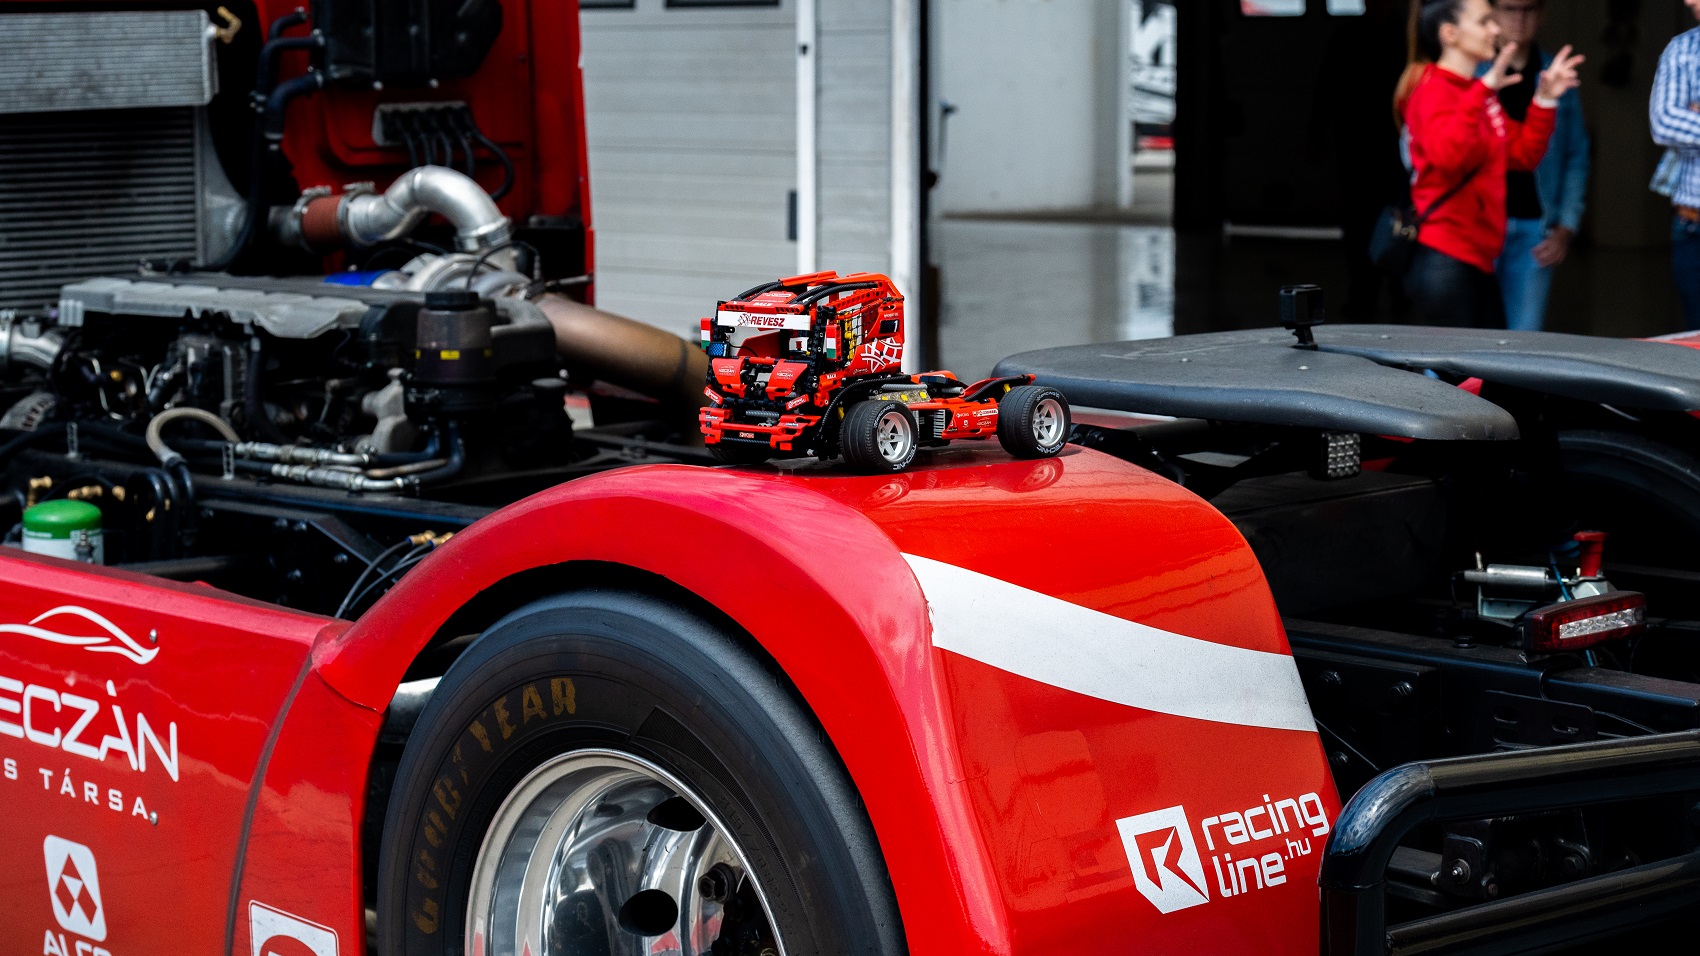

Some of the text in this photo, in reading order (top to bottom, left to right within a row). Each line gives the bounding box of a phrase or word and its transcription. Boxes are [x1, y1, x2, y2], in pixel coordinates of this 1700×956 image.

[750, 315, 785, 327] REVESZ
[892, 443, 917, 471] TECHNIC
[1036, 441, 1064, 454] TECHNIC
[38, 767, 149, 820] TÁRSA
[1201, 791, 1330, 851] racing
